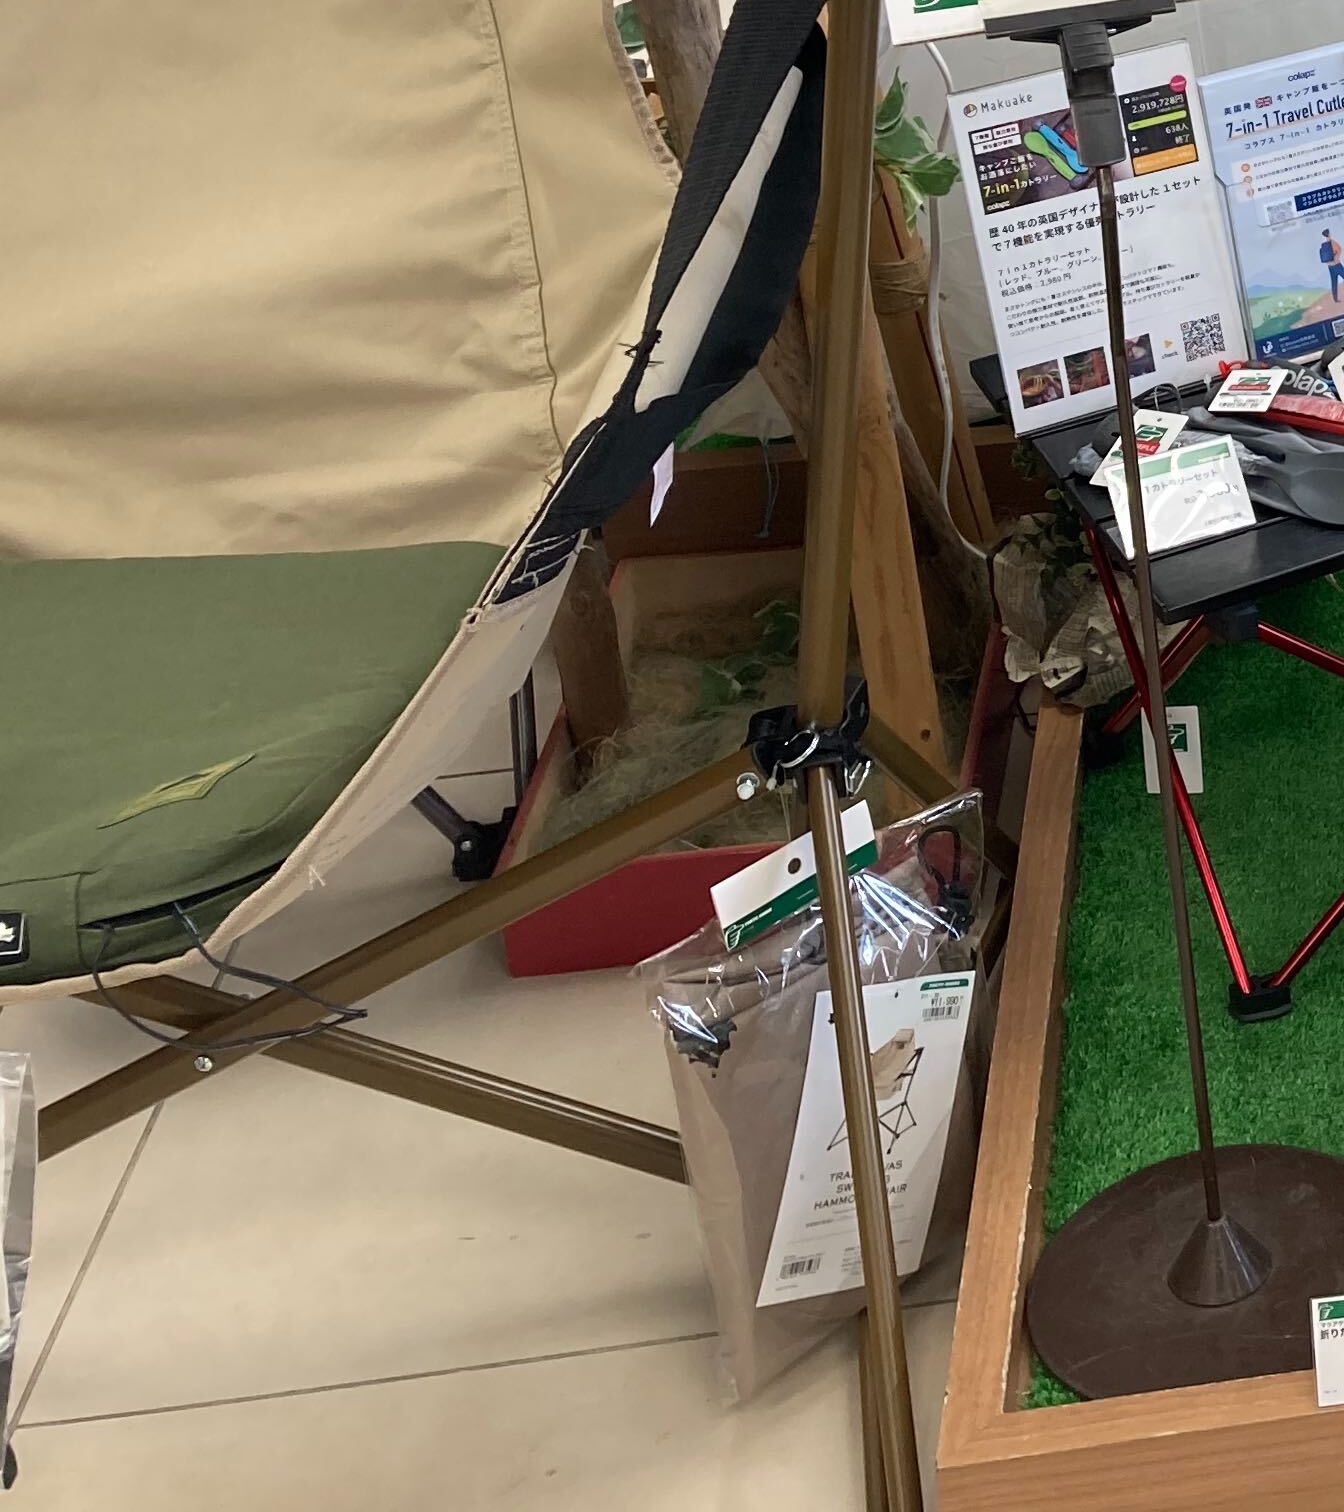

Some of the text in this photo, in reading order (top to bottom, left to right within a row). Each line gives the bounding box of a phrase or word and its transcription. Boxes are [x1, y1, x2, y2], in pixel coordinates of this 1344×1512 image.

[980, 93, 1034, 114] Makuake
[1225, 113, 1270, 139] 7-in-1
[1274, 101, 1313, 127] Travel
